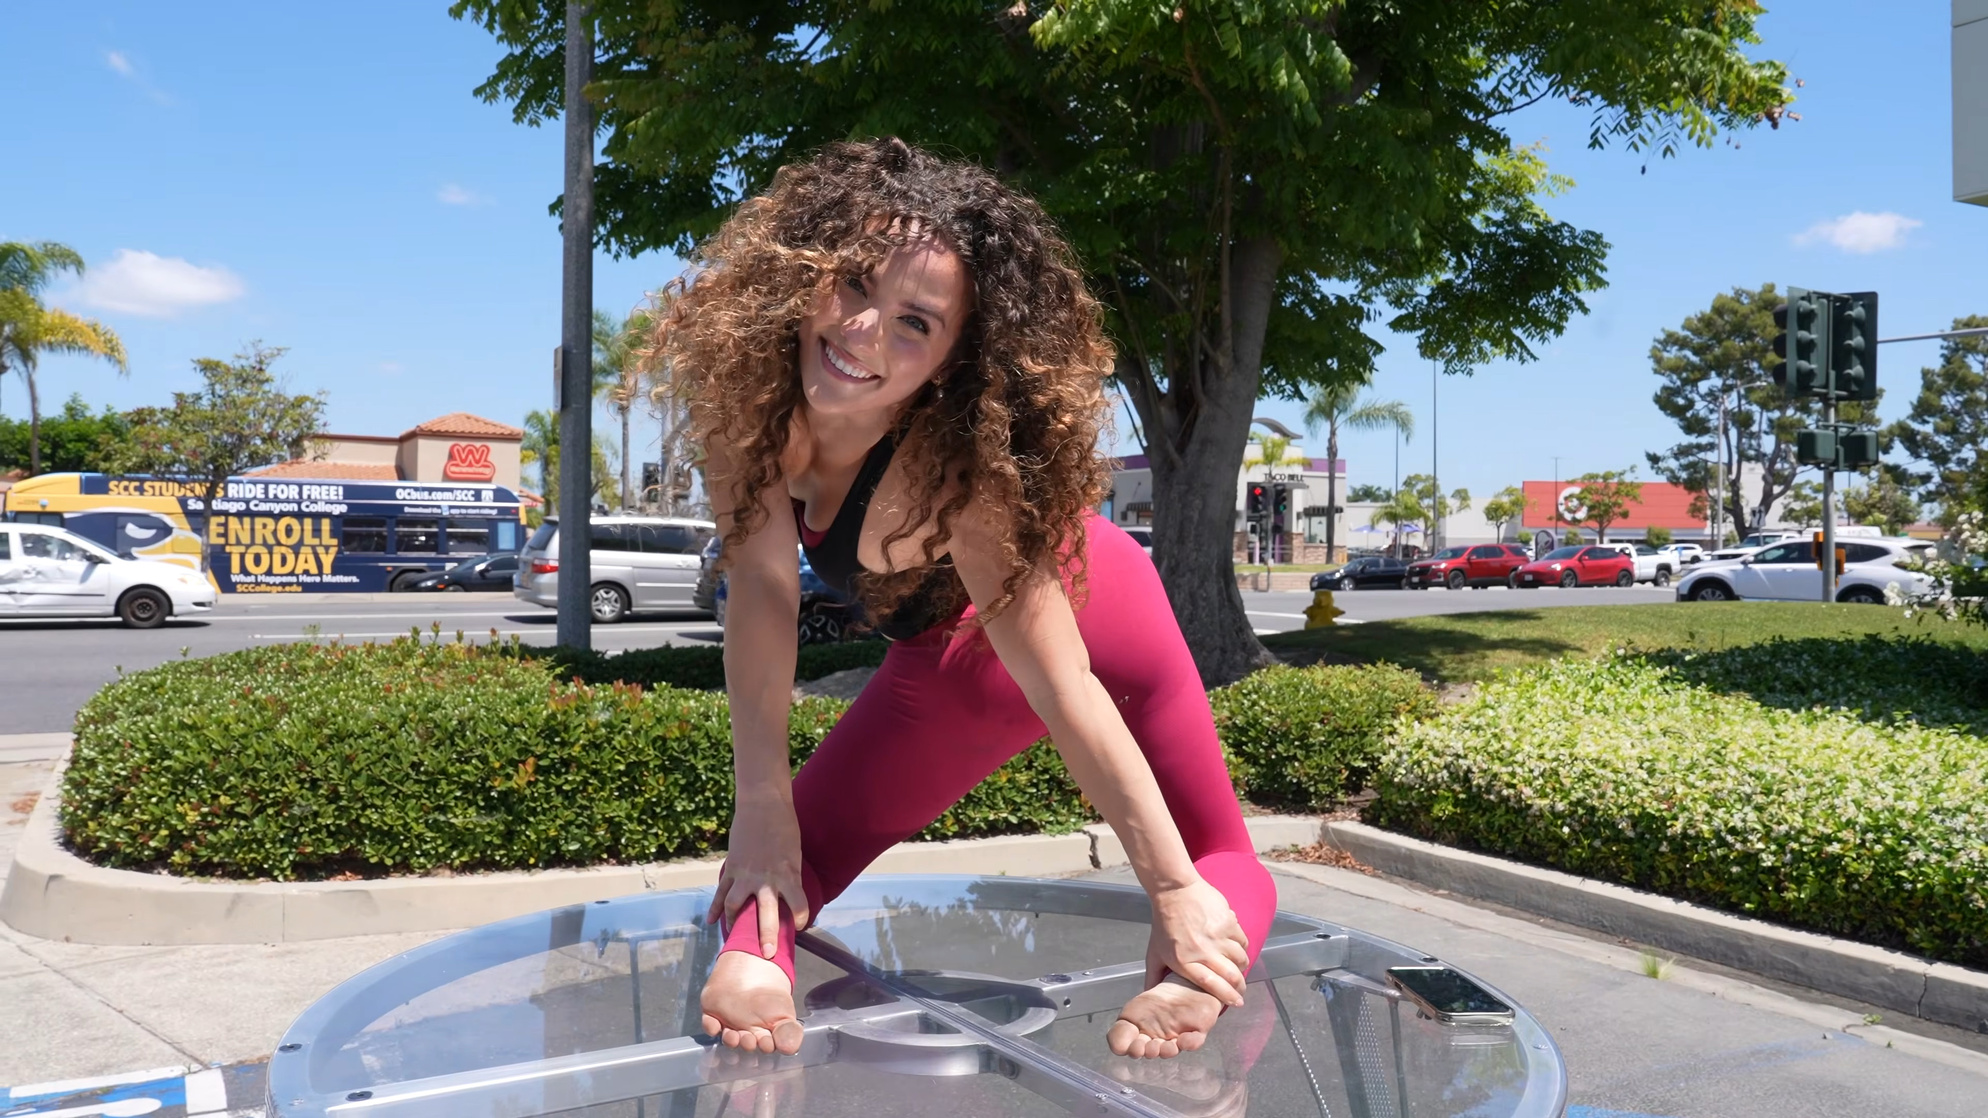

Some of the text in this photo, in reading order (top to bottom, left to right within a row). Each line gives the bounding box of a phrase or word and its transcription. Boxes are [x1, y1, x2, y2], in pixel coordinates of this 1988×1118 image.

[108, 480, 344, 501] SCC STUDENS RIDE FOR FREE!
[395, 488, 475, 501] OCbus.com/SCC
[186, 498, 348, 515] Satiago Canyon College
[209, 516, 339, 546] ENROLL
[225, 545, 339, 575] TODAY
[230, 574, 359, 584] What Happens Here Matters.
[236, 584, 302, 594] SCCollege.edu
